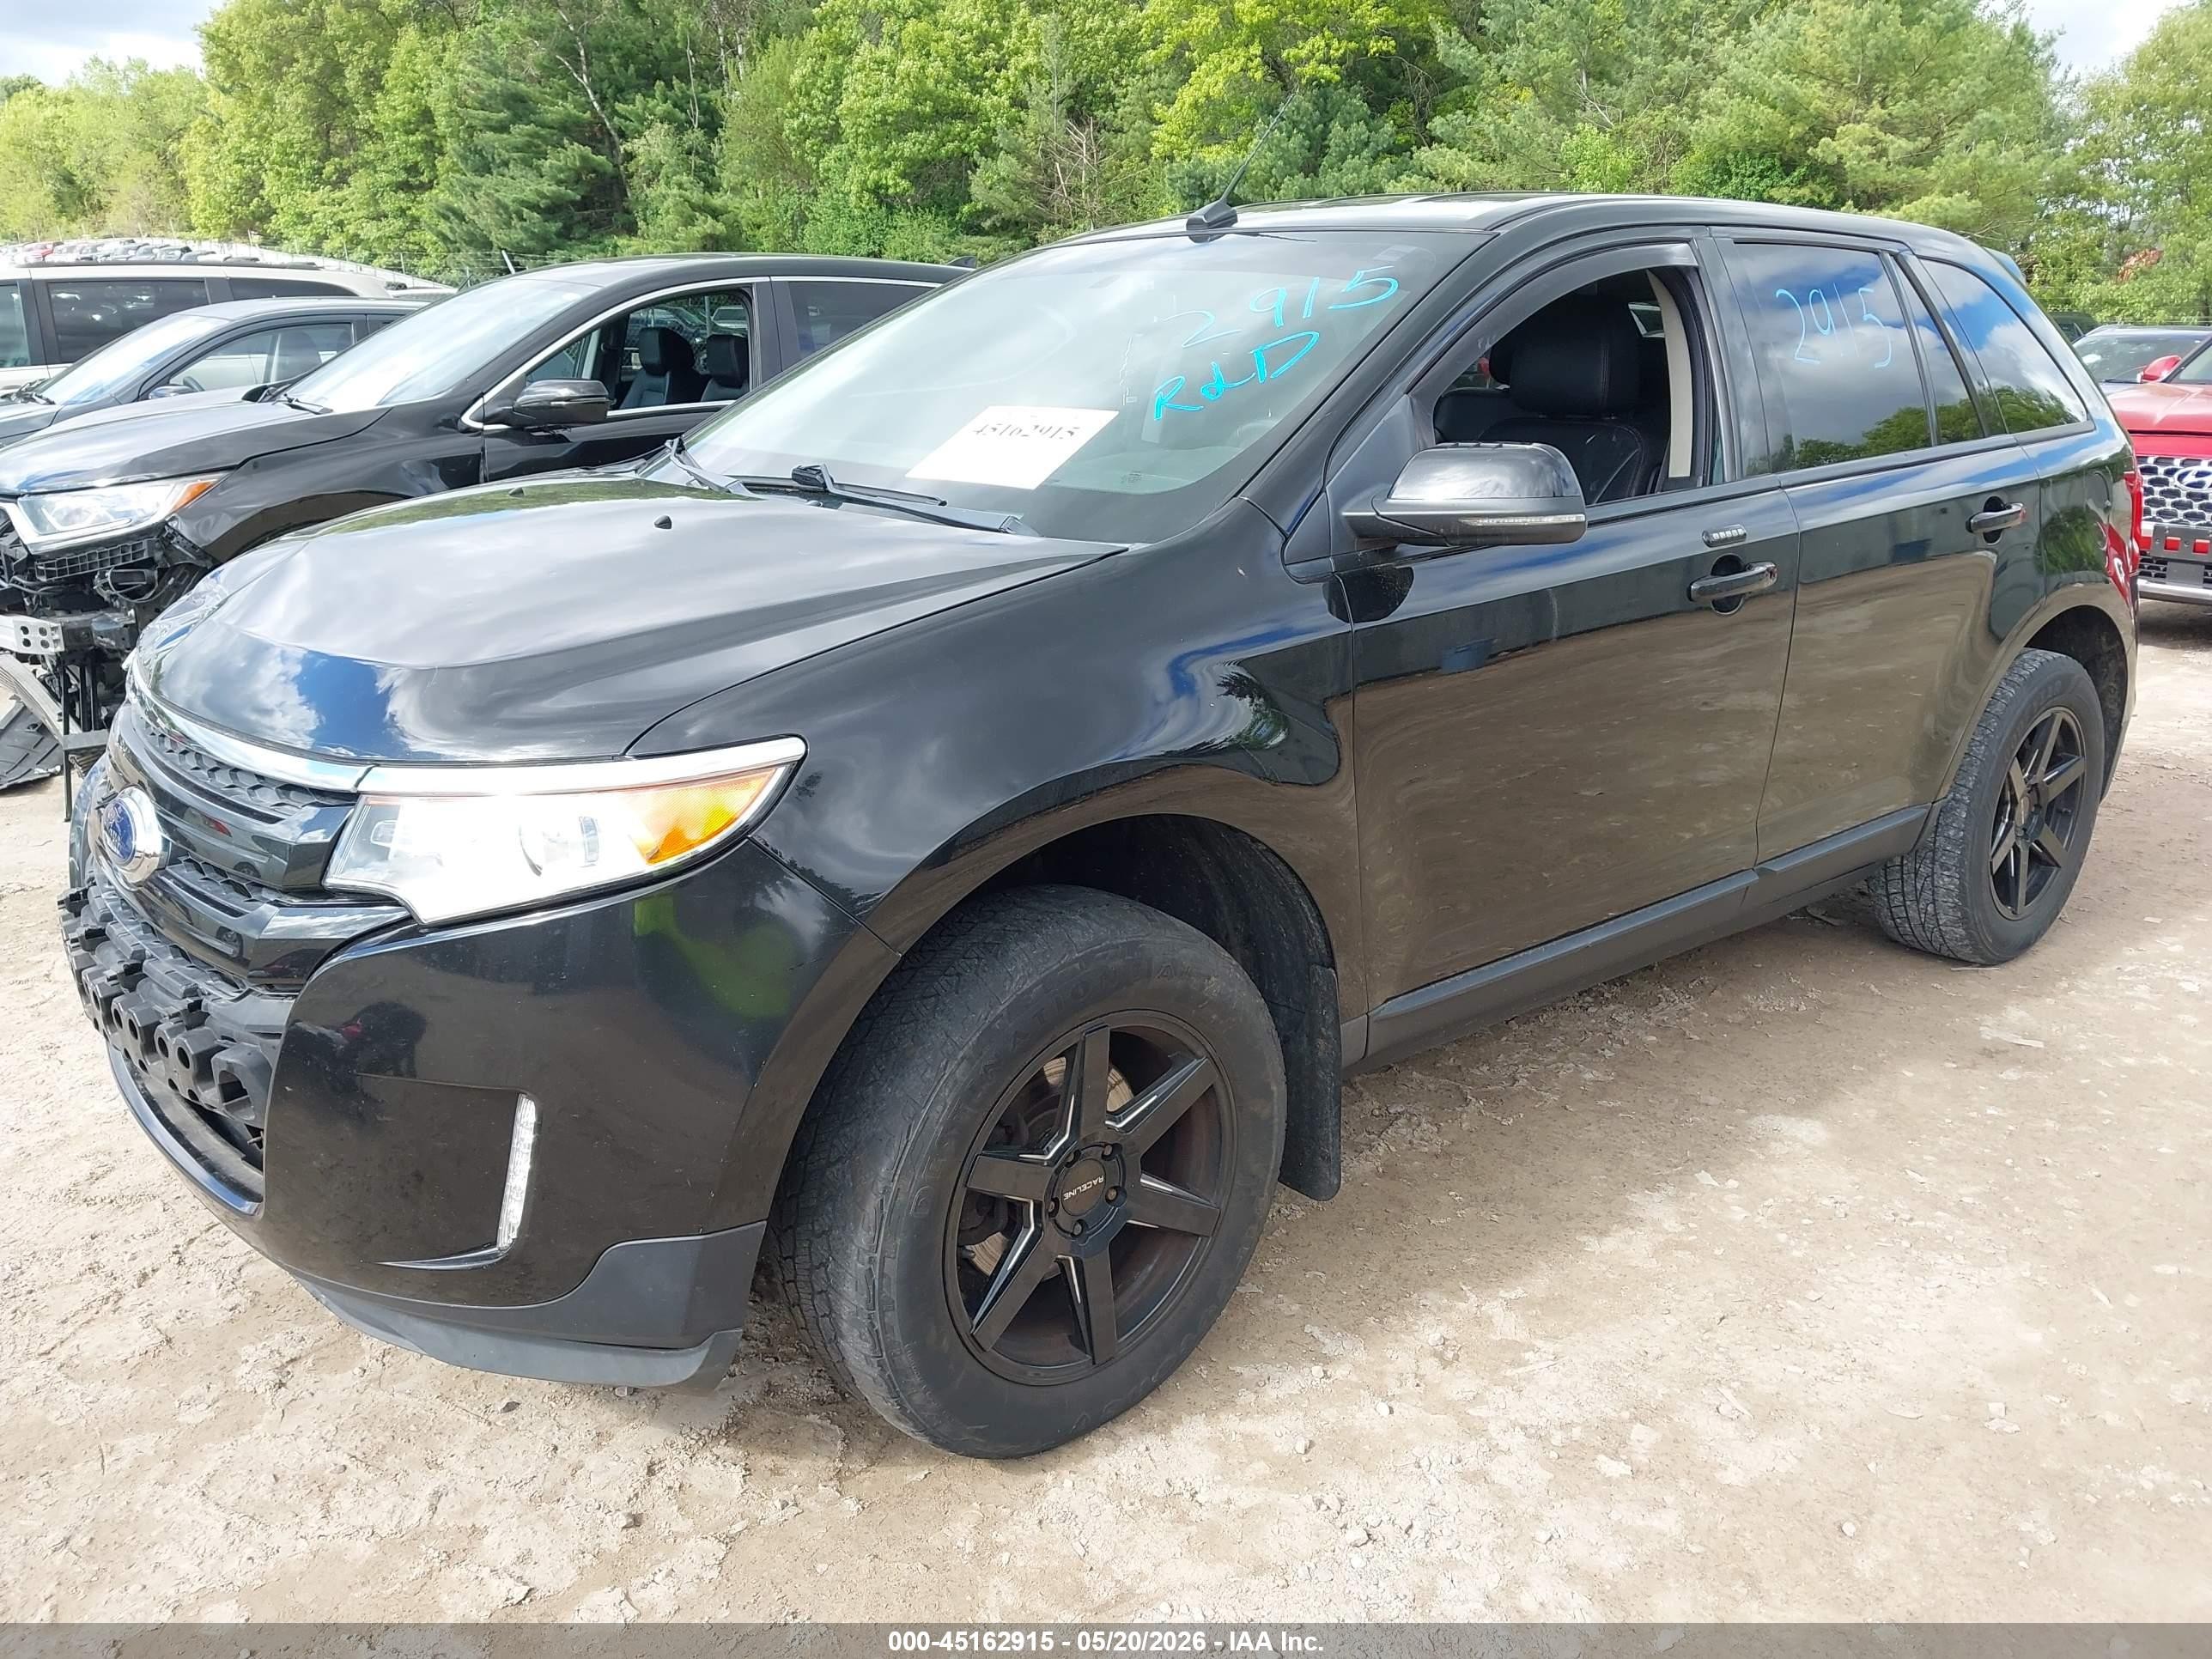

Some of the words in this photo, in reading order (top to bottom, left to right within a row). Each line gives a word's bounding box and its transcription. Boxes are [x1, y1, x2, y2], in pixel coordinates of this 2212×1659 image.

[1159, 265, 1399, 348] 2915
[1774, 282, 1892, 368] 2915
[1063, 1175, 1104, 1200] RACELINE
